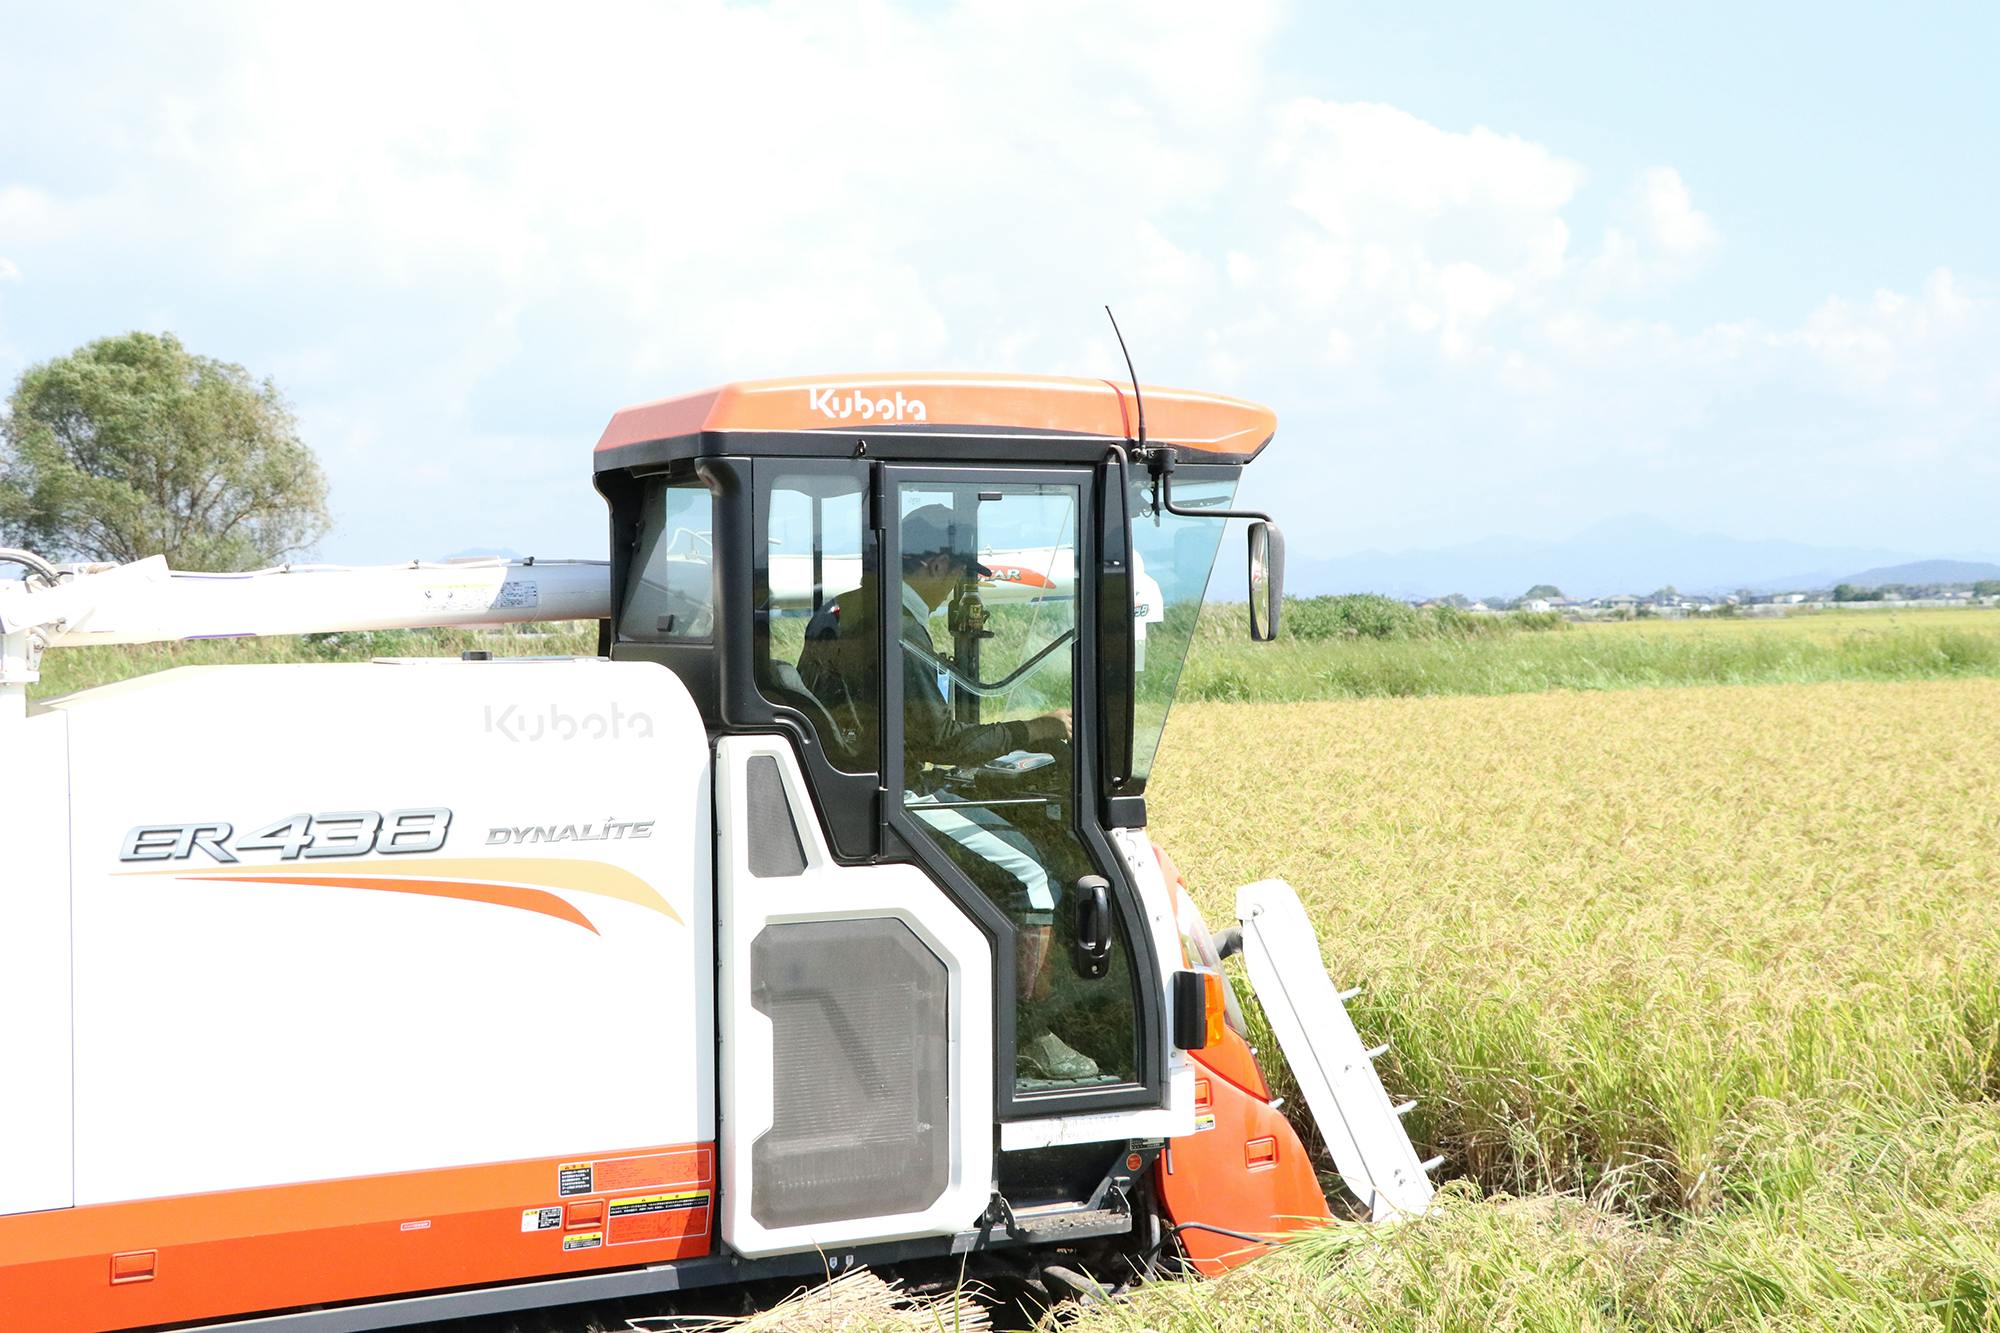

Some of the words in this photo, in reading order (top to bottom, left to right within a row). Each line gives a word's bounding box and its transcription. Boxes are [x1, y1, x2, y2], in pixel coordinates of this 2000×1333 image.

[810, 388, 926, 421] Kubota
[484, 701, 655, 743] Kubota
[484, 816, 656, 845] DYNALITE
